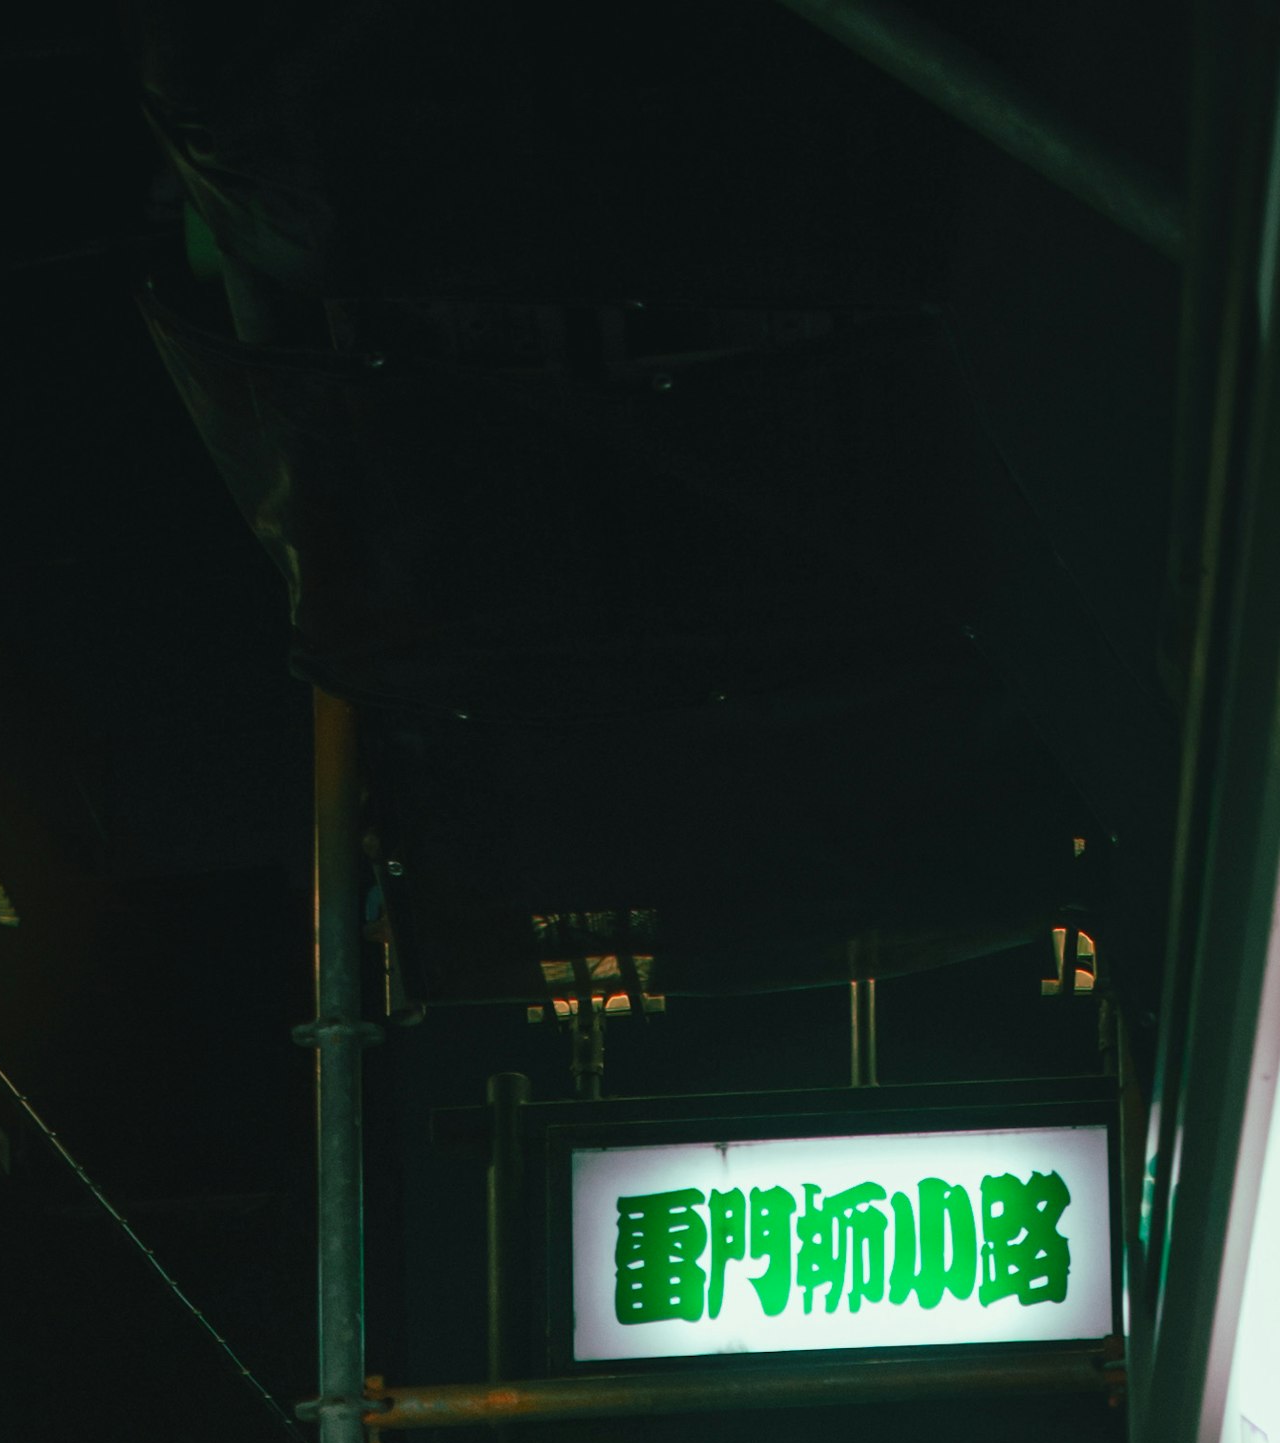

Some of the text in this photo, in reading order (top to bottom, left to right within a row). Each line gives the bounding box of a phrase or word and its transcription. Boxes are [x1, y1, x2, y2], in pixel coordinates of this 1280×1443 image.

[615, 1169, 1070, 1324] 雷門柳小路
